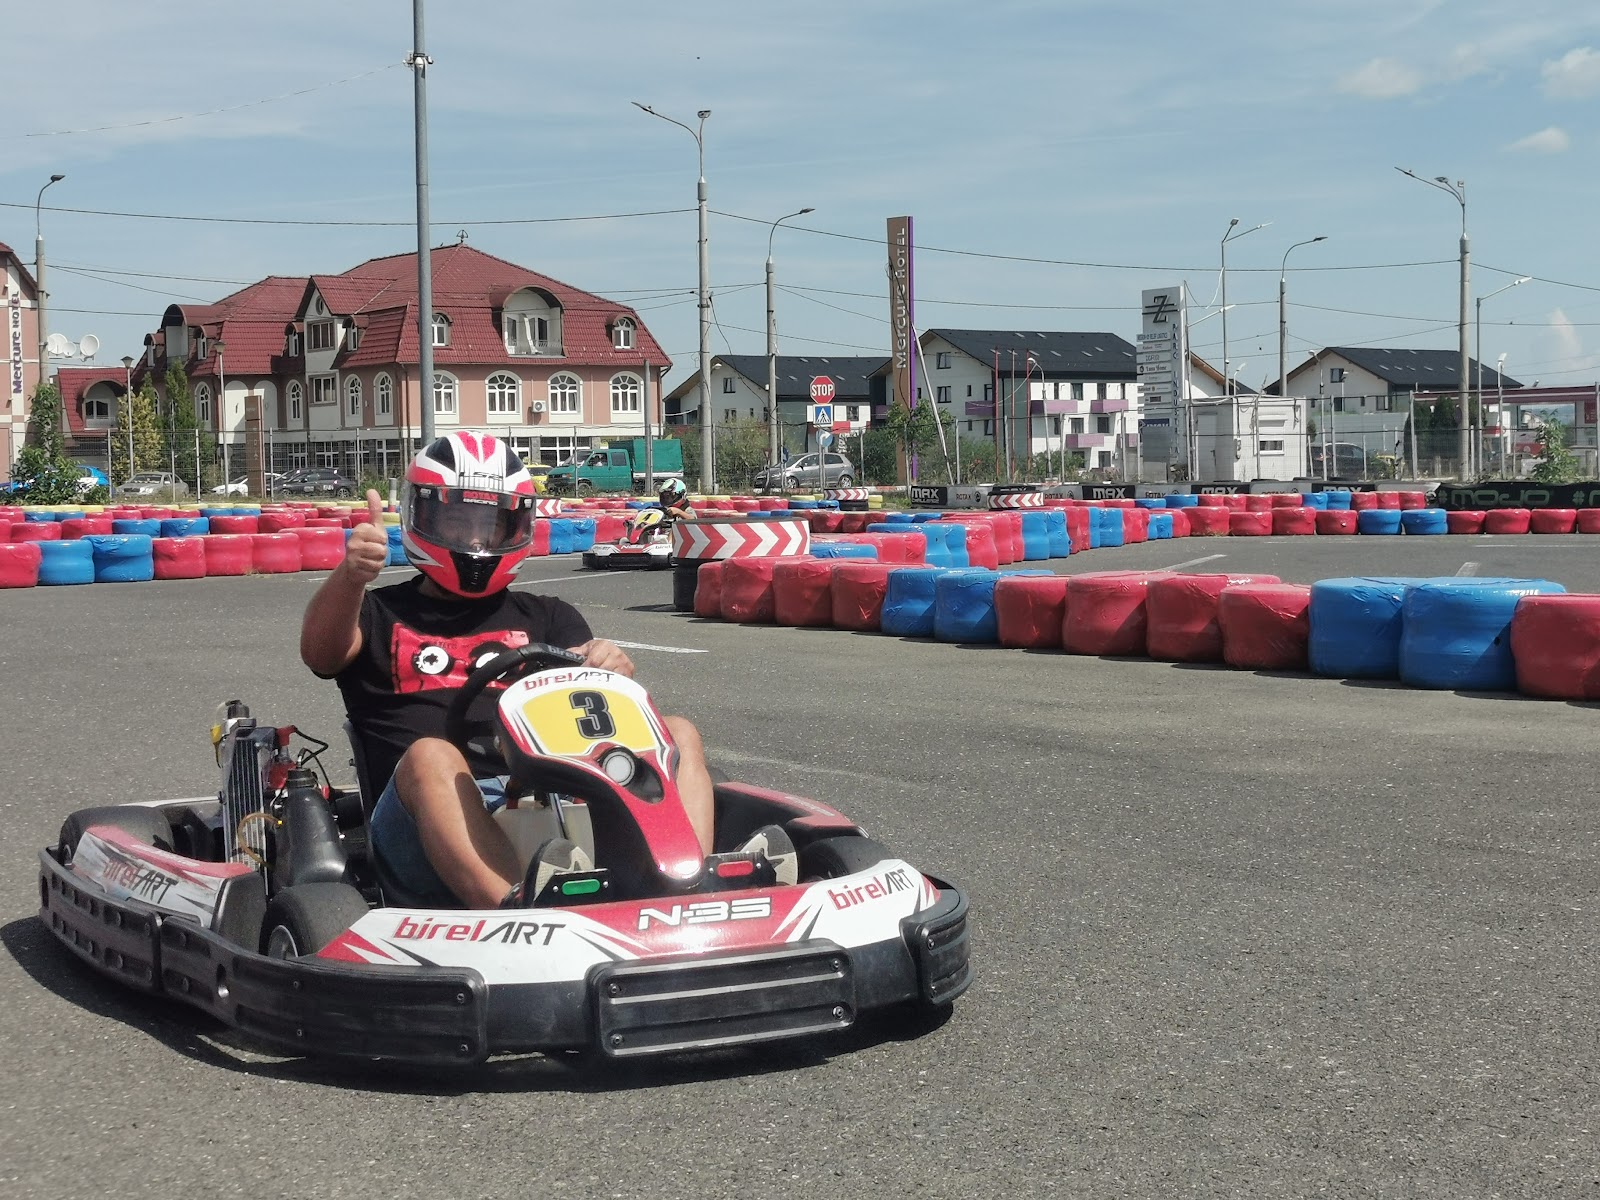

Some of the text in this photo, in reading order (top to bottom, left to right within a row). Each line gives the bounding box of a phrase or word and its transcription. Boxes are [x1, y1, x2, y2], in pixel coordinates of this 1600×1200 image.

[11, 290, 23, 394] Mercure HOTEL
[811, 384, 834, 396] STOP
[911, 487, 940, 499] MAX
[955, 493, 973, 501] ROTAX
[1092, 487, 1126, 499] MAX
[1451, 489, 1550, 506] MOJO
[523, 671, 615, 691] birelART
[568, 690, 617, 740] 3
[828, 867, 920, 912] birelART
[393, 916, 567, 947] birelART
